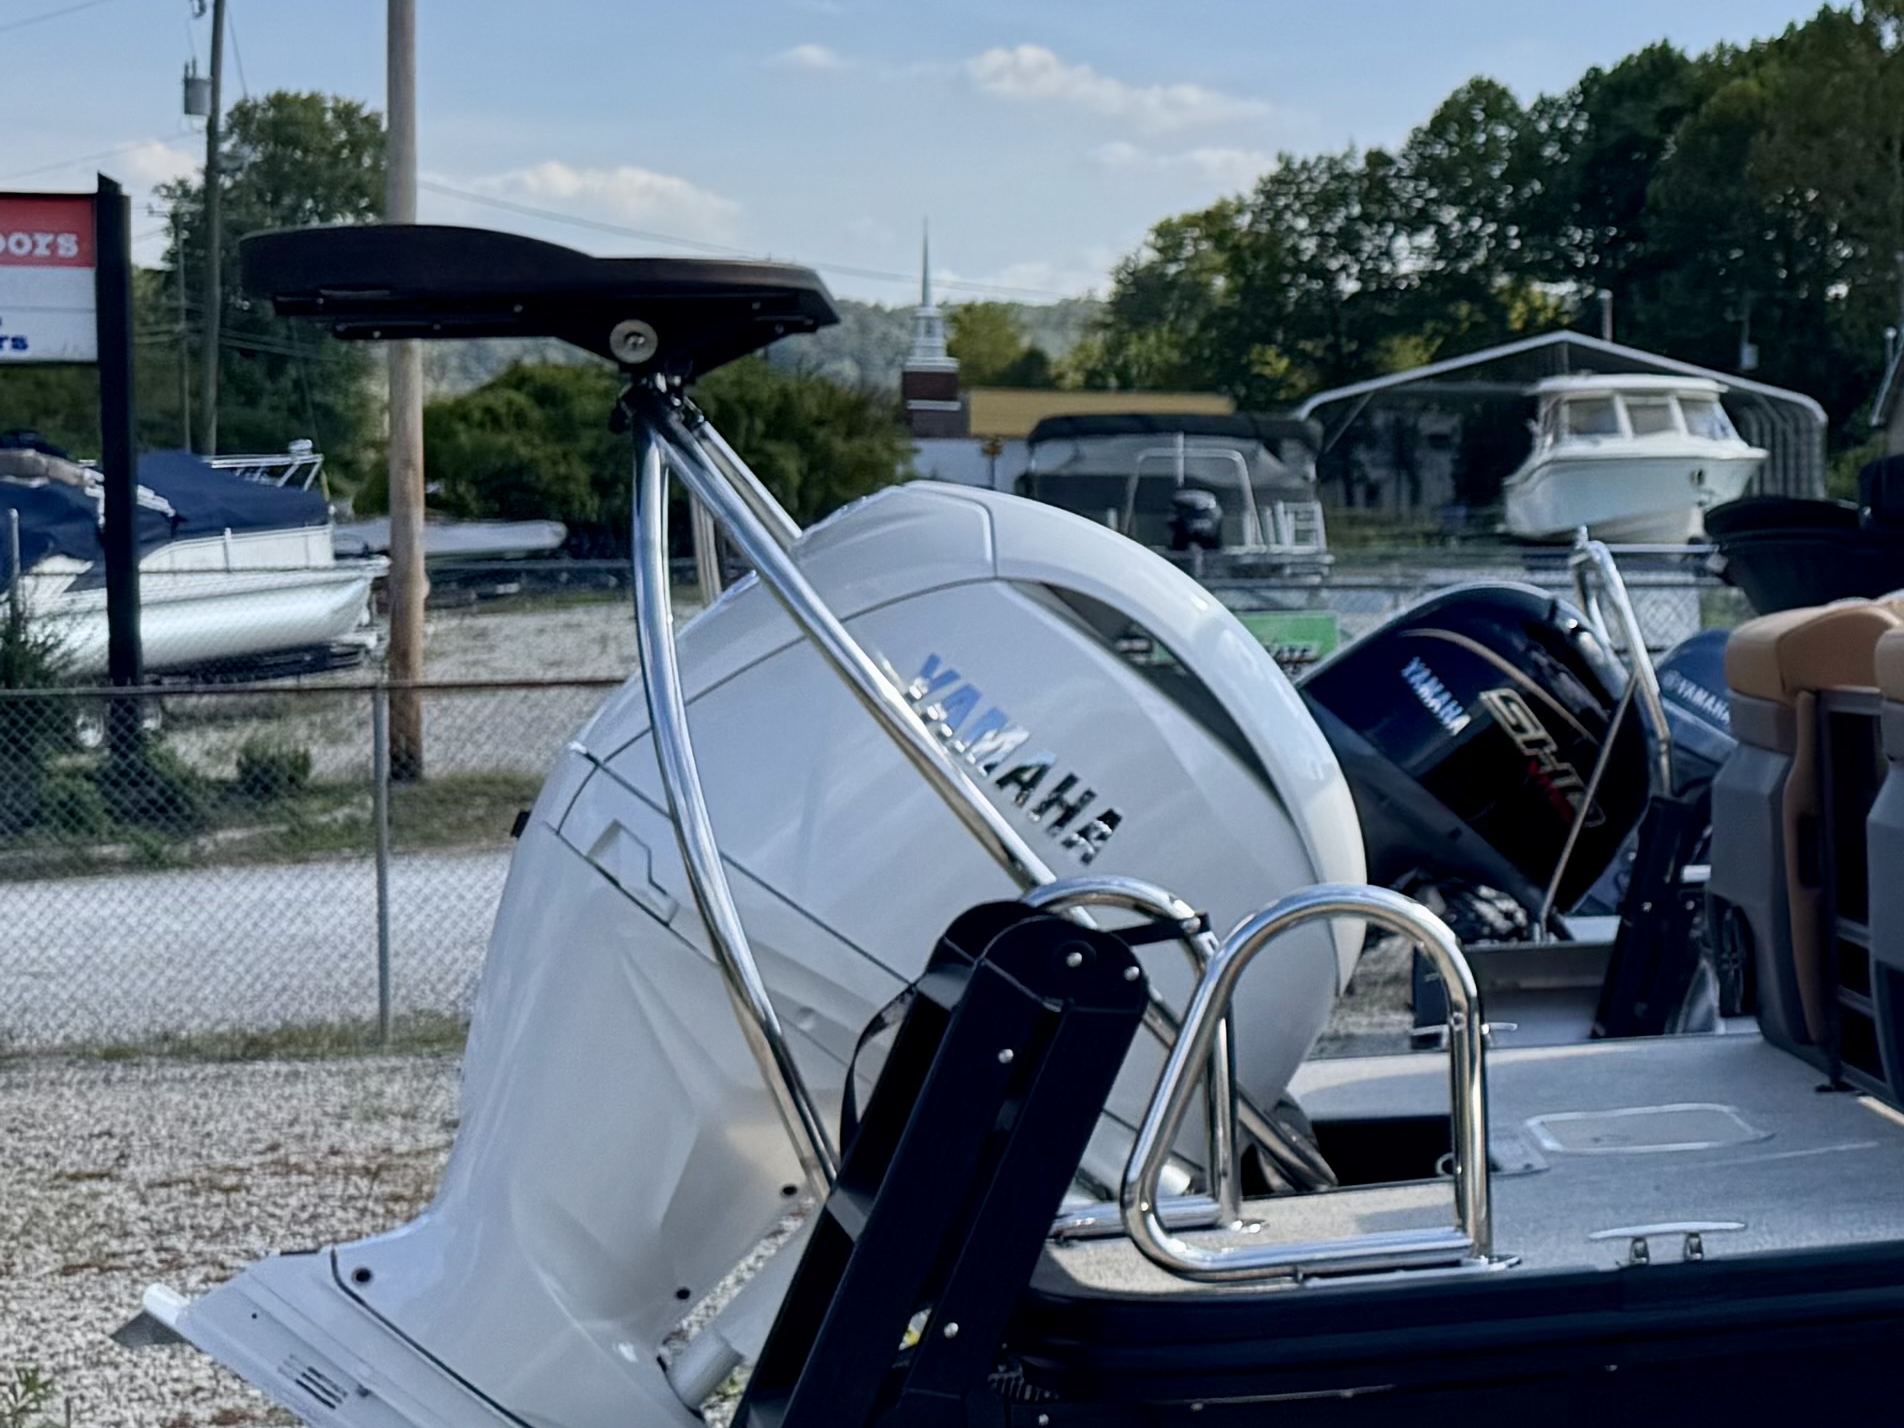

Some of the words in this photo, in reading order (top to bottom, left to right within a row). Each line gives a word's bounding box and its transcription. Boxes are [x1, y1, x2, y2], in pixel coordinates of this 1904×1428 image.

[0, 231, 79, 259] ors
[1401, 656, 1472, 736] YAMAHA
[904, 652, 1123, 867] YAMAHA
